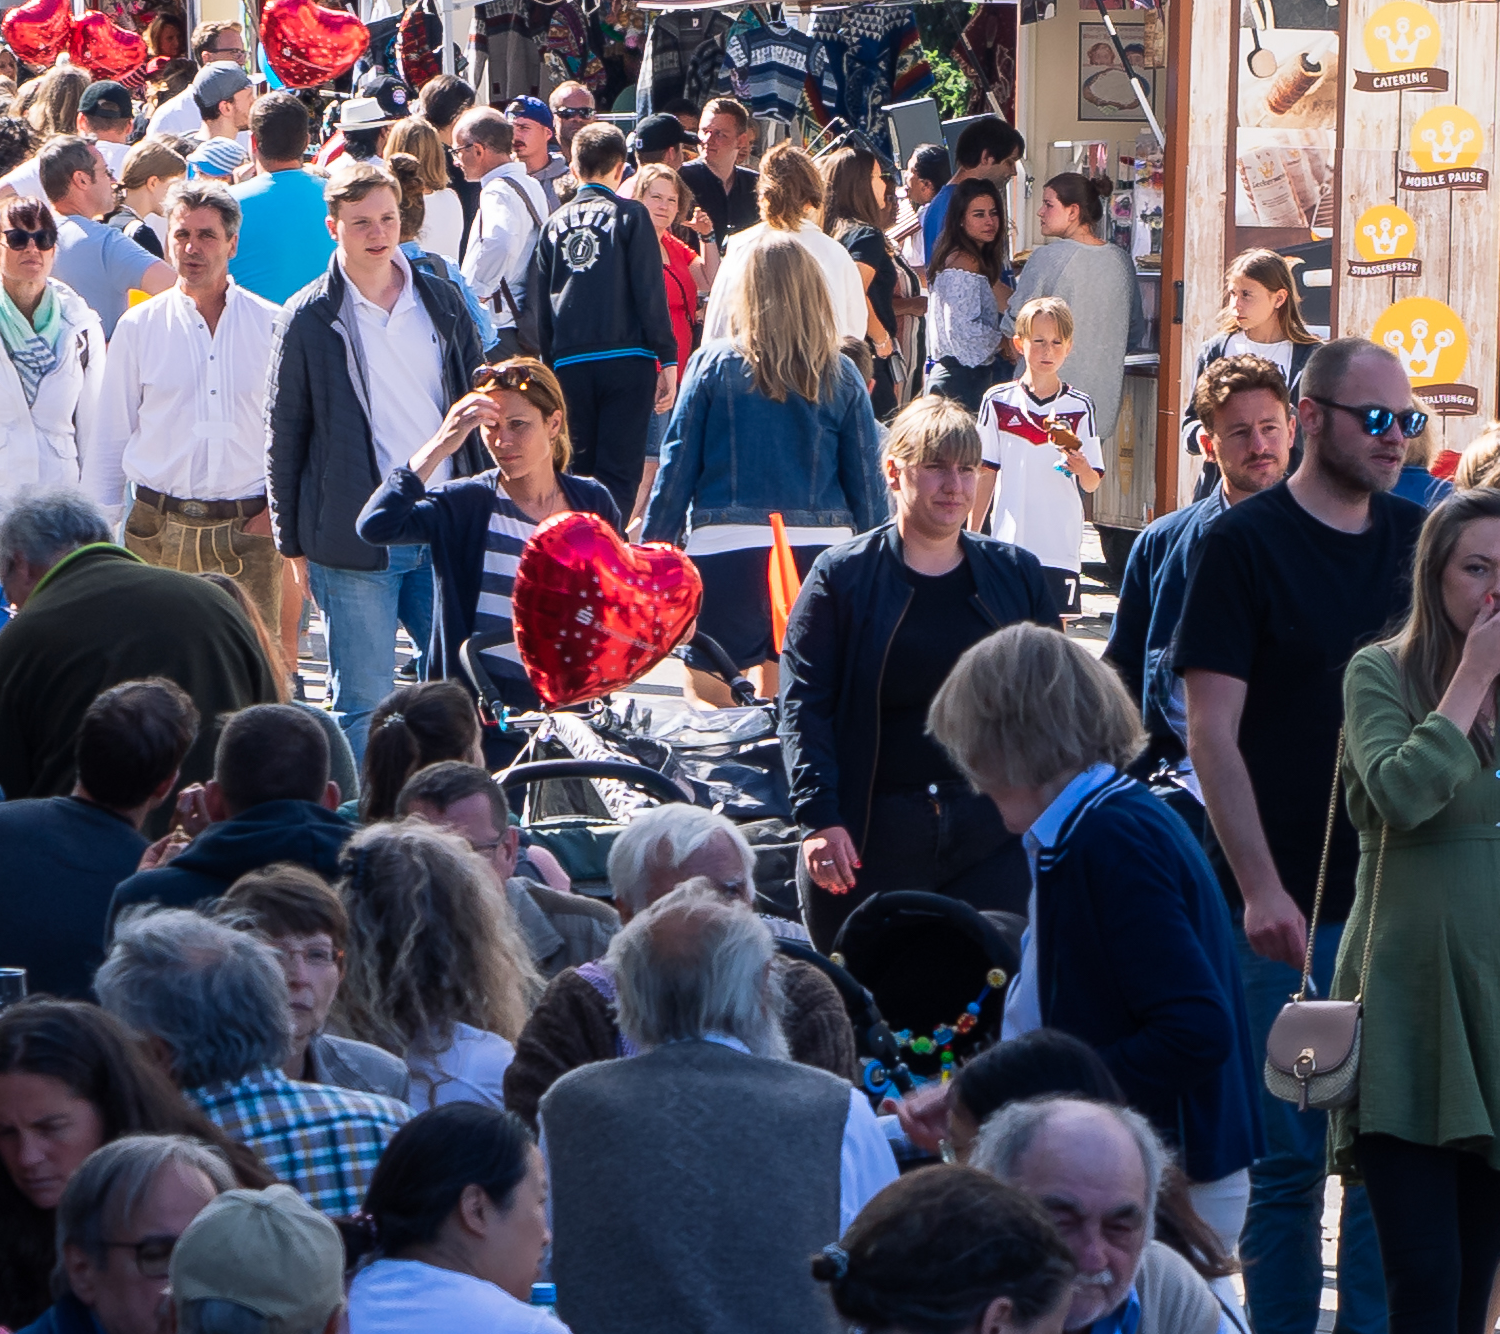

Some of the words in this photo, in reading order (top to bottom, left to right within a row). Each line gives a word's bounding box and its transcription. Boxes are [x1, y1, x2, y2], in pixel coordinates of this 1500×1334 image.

[1372, 71, 1429, 89] CATERING
[1404, 175, 1445, 187] MOBILE
[1448, 171, 1484, 183] PAUSE
[1064, 578, 1077, 606] 7
